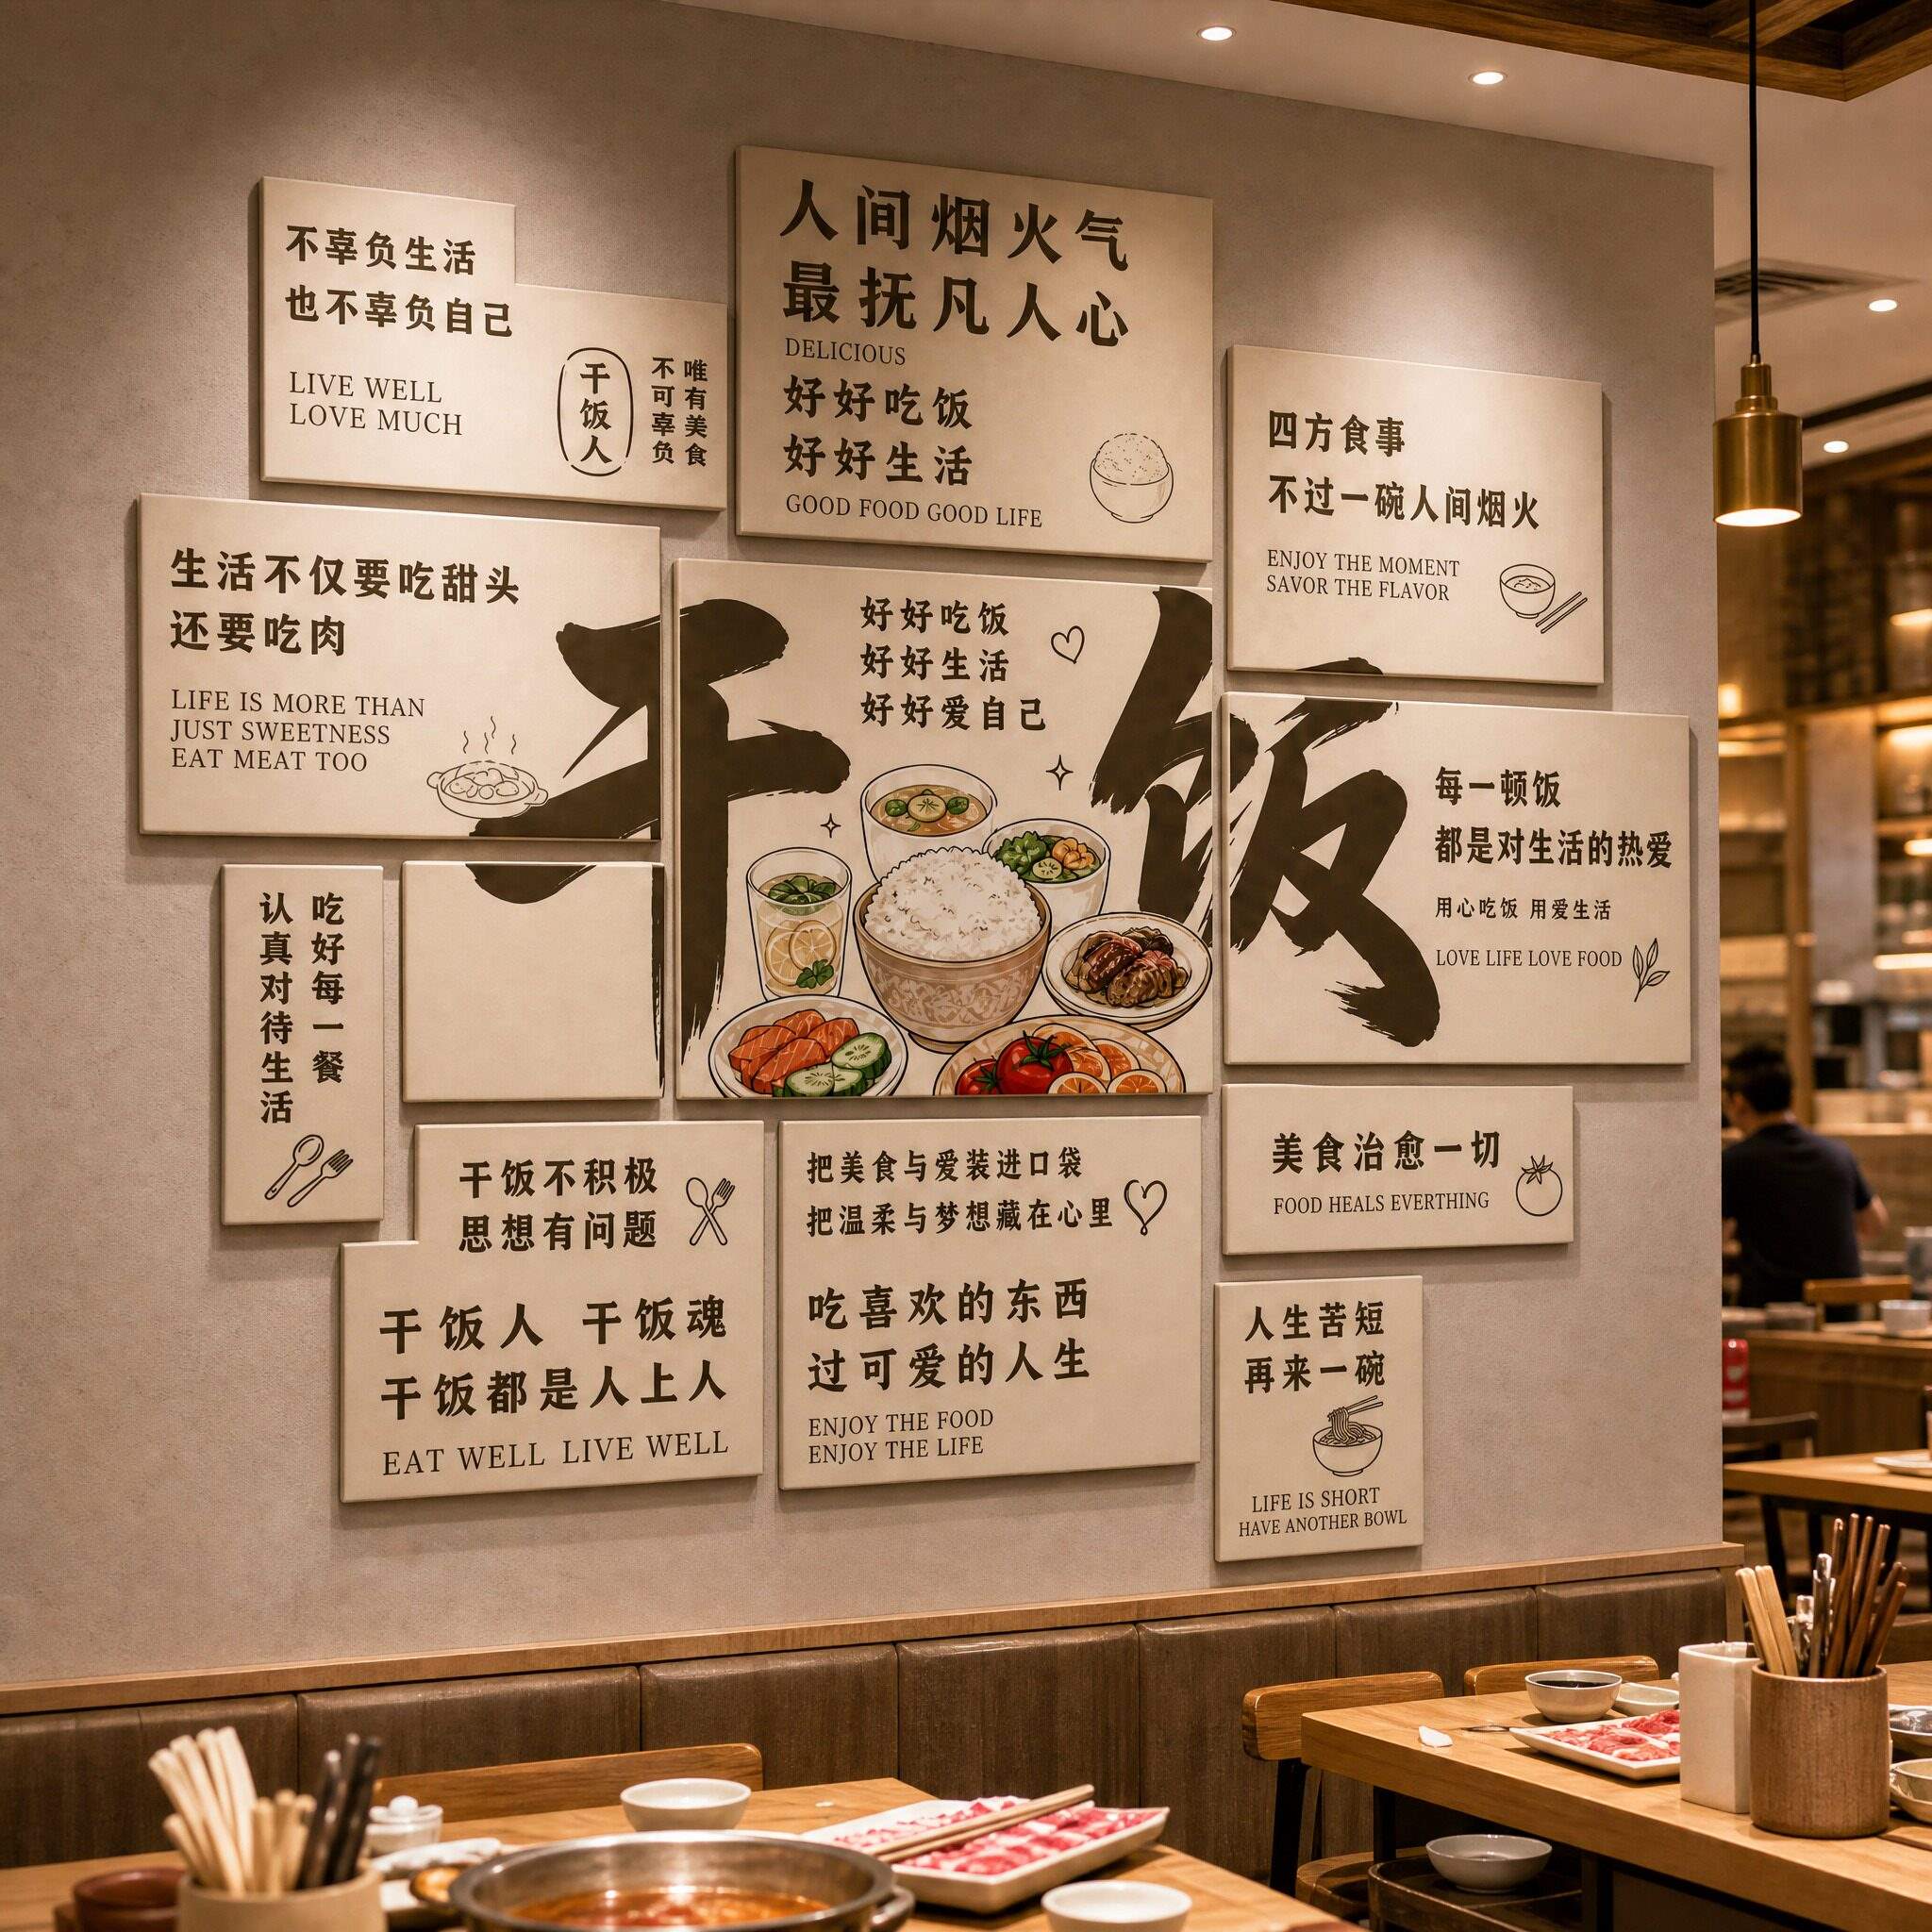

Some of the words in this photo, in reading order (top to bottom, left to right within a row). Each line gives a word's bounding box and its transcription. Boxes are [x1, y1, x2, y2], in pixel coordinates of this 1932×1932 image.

[780, 179, 1128, 271] 人间烟火气
[286, 225, 475, 275] 不辜负生活
[285, 285, 512, 337] 也不辜负自己
[782, 261, 1128, 346] 最抚凡人心
[786, 338, 905, 365] DELICIOUS
[290, 372, 354, 396] LIVE
[364, 377, 441, 402] WELL
[784, 375, 972, 429] 好好吃饭
[291, 403, 365, 428] LOVE
[378, 409, 461, 435] MUCH
[580, 363, 612, 463] 干饭人
[652, 358, 675, 464] 不可辜负
[684, 359, 708, 466] 唯有美食
[1270, 410, 1405, 457] 四方食事
[783, 433, 972, 485] 好好生活
[787, 494, 850, 515] GOOD
[859, 499, 919, 519] FOOD
[927, 504, 988, 524] GOOD
[996, 508, 1041, 527] LIFE
[1269, 475, 1539, 529] 不过一碗人间烟火
[171, 547, 519, 604] 生活不仅要吃甜头
[1268, 550, 1326, 570] ENJOY
[1334, 554, 1372, 572] THE
[1379, 557, 1459, 576] MOMENT
[1267, 575, 1328, 594] SAVOR
[1335, 579, 1372, 596] THE
[1379, 581, 1449, 600] FLAVOR
[171, 610, 344, 656] 还要吃肉
[860, 595, 1008, 636] 好好吃饭
[860, 642, 1008, 682] 好好生活
[172, 690, 229, 710] LIFE
[241, 692, 261, 711] IS
[274, 693, 345, 714] MORE
[356, 696, 425, 716] THAN
[860, 691, 1045, 730] 好好爱自己
[171, 720, 232, 741] JUST
[242, 722, 389, 744] SWEETNESS
[172, 748, 223, 768] EAT
[234, 750, 306, 770] MEAT
[315, 752, 366, 772] TOO
[1436, 766, 1560, 808] 每一顿饭
[1435, 825, 1672, 868] 都是对生活的热爱
[1436, 897, 1518, 918] 用心吃饭
[1530, 898, 1610, 920] 用爱生活
[1437, 950, 1479, 966] LOVE
[1487, 950, 1522, 966] LIFE
[1529, 950, 1572, 966] LOVE
[1578, 951, 1622, 967] FOOD
[259, 892, 293, 1124] 认真对待生活
[311, 892, 344, 1083] 吃好每一餐
[807, 1147, 1081, 1184] 把美食与爱装进口袋
[1273, 1130, 1499, 1174] 美食治愈一切
[459, 1157, 657, 1198] 干饭不积极
[807, 1197, 1112, 1237] 把温柔与梦想藏在心里
[1274, 1197, 1322, 1214] FOOD
[1329, 1195, 1384, 1212] HEALS
[1391, 1191, 1489, 1210] EVERTHING
[459, 1210, 656, 1253] 思想有问题
[380, 1303, 543, 1354] 干饭人
[582, 1294, 726, 1344] 干饭魂
[808, 1278, 1087, 1330] 吃喜欢的东西
[1245, 1301, 1384, 1341] 人生苦短
[808, 1338, 1089, 1391] 过可爱的人生
[1245, 1350, 1385, 1393] 再来一碗
[381, 1359, 726, 1420] 干饭都是人上人
[809, 1415, 877, 1438] ENJOY
[886, 1412, 928, 1432] THE
[938, 1409, 993, 1429] FOOD
[383, 1449, 443, 1475] EAT
[458, 1442, 544, 1470] WELL
[563, 1437, 633, 1463] LIVE
[646, 1431, 728, 1457] WELL
[808, 1442, 877, 1464] ENJOY
[886, 1440, 928, 1458] THE
[938, 1436, 983, 1456] LIFE
[1253, 1494, 1291, 1512] LIFE
[1299, 1492, 1314, 1508] IS
[1322, 1488, 1379, 1507] SHORT
[1240, 1520, 1280, 1537] HAVE
[1285, 1514, 1358, 1533] ANOTHER
[1365, 1509, 1407, 1526] BOWL
